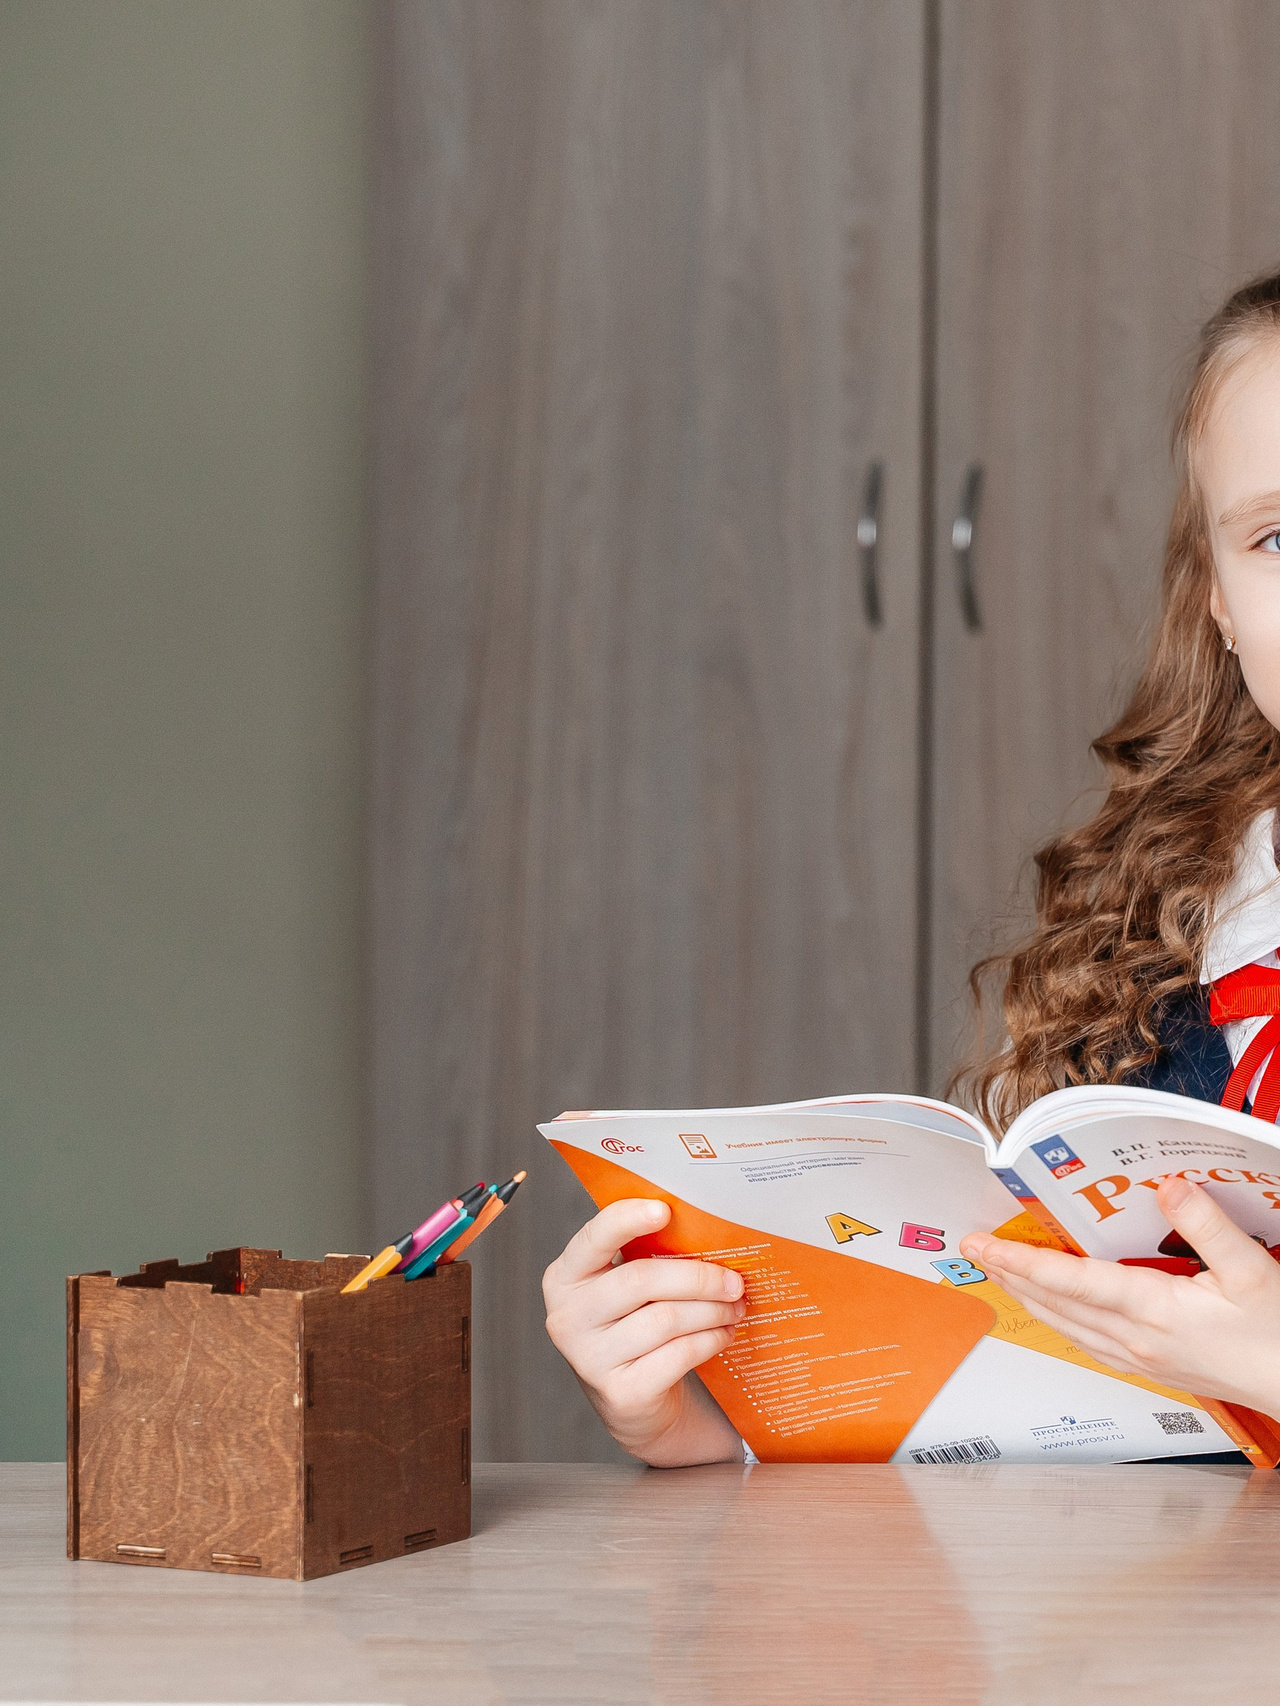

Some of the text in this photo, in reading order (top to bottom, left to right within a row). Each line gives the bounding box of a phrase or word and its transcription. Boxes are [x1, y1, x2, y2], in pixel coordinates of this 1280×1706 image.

[765, 1138, 794, 1146] имеет
[1160, 1149, 1247, 1159] Горецкий
[748, 1172, 803, 1182] shop.prosv.ru
[899, 1221, 946, 1252] Б
[1032, 1421, 1117, 1437] ПРОСВЕЩЕНИЕ
[1040, 1433, 1125, 1450] www.prosv.ru
[909, 1447, 926, 1455] ISBN
